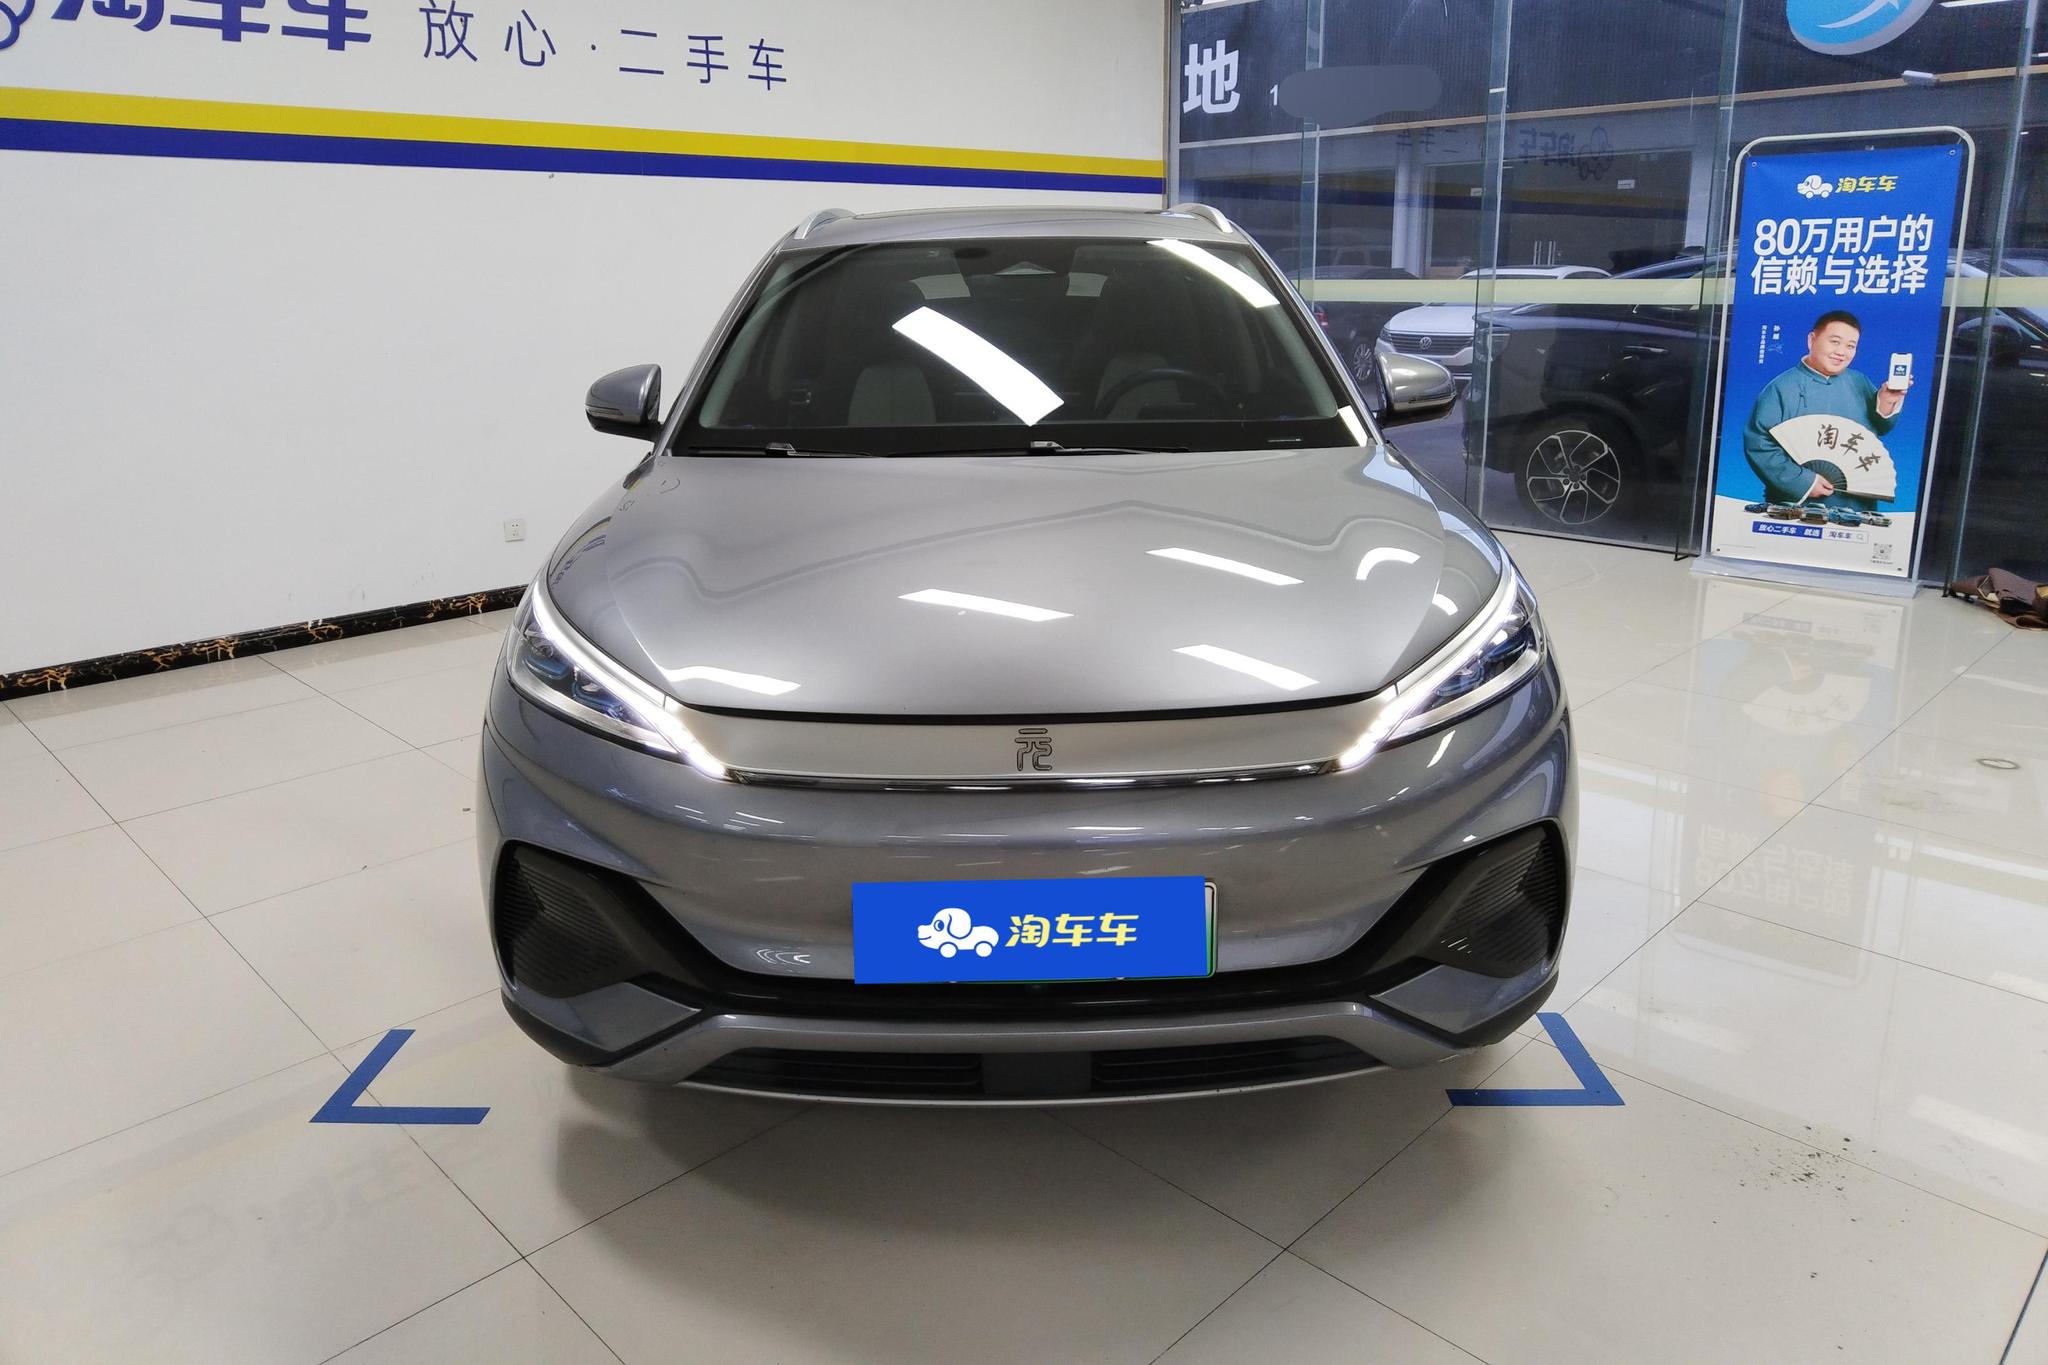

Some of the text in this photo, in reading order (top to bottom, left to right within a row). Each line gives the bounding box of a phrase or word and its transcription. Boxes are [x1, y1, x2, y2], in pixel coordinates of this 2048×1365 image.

[1183, 39, 1241, 114] 地
[1835, 175, 1899, 194] 淘车车
[1753, 213, 1934, 256] 80万用户的
[1751, 254, 1929, 295] 信赖与选择
[1817, 423, 1881, 472] 淘车车
